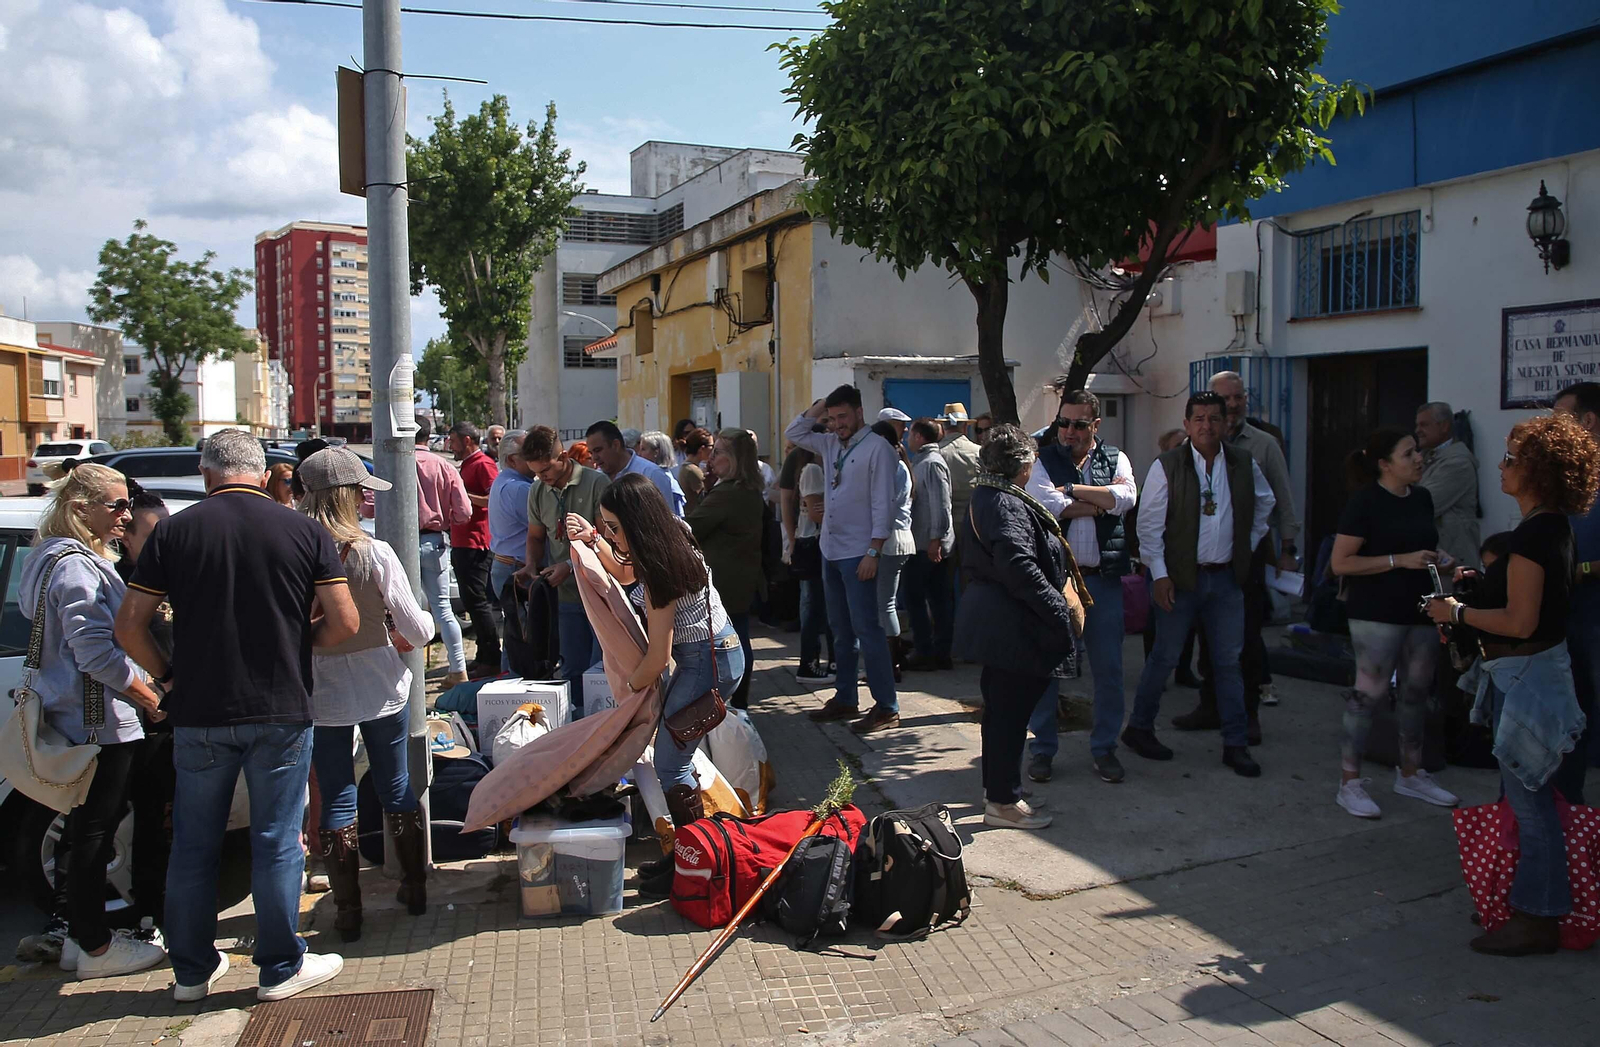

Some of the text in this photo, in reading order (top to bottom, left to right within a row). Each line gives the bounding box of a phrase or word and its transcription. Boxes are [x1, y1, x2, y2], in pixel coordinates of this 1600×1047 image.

[1515, 335, 1600, 351] CASA HERMANDA
[1553, 351, 1565, 362] DE
[1517, 365, 1559, 378] NUESTRA
[1535, 380, 1552, 392] DEL
